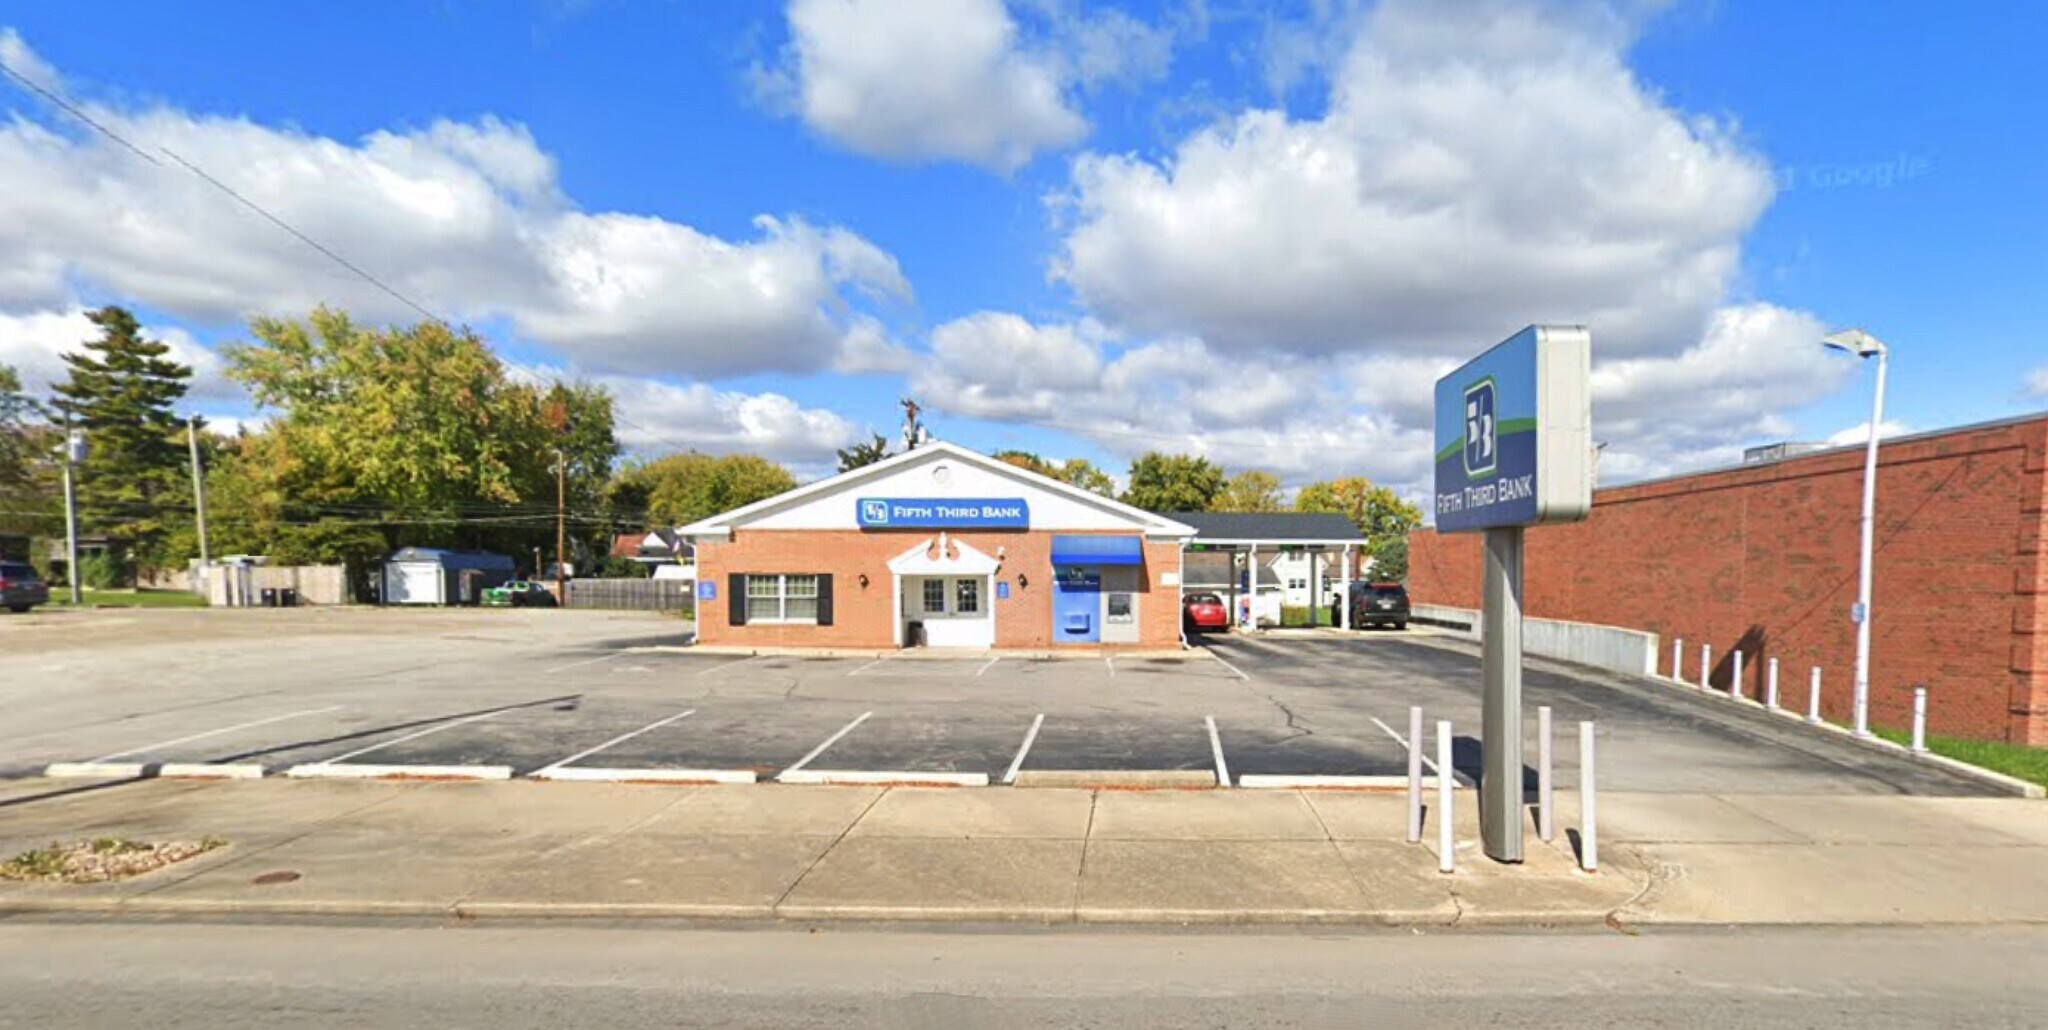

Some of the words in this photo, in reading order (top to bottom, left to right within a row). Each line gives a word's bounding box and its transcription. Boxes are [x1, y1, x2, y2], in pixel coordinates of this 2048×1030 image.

[1437, 492, 1462, 514] FIFTH
[1464, 484, 1496, 509] THIRD
[1499, 474, 1533, 501] BANK
[894, 506, 932, 518] FIFTH
[936, 506, 979, 518] THIRD
[982, 506, 1021, 518] BANK
